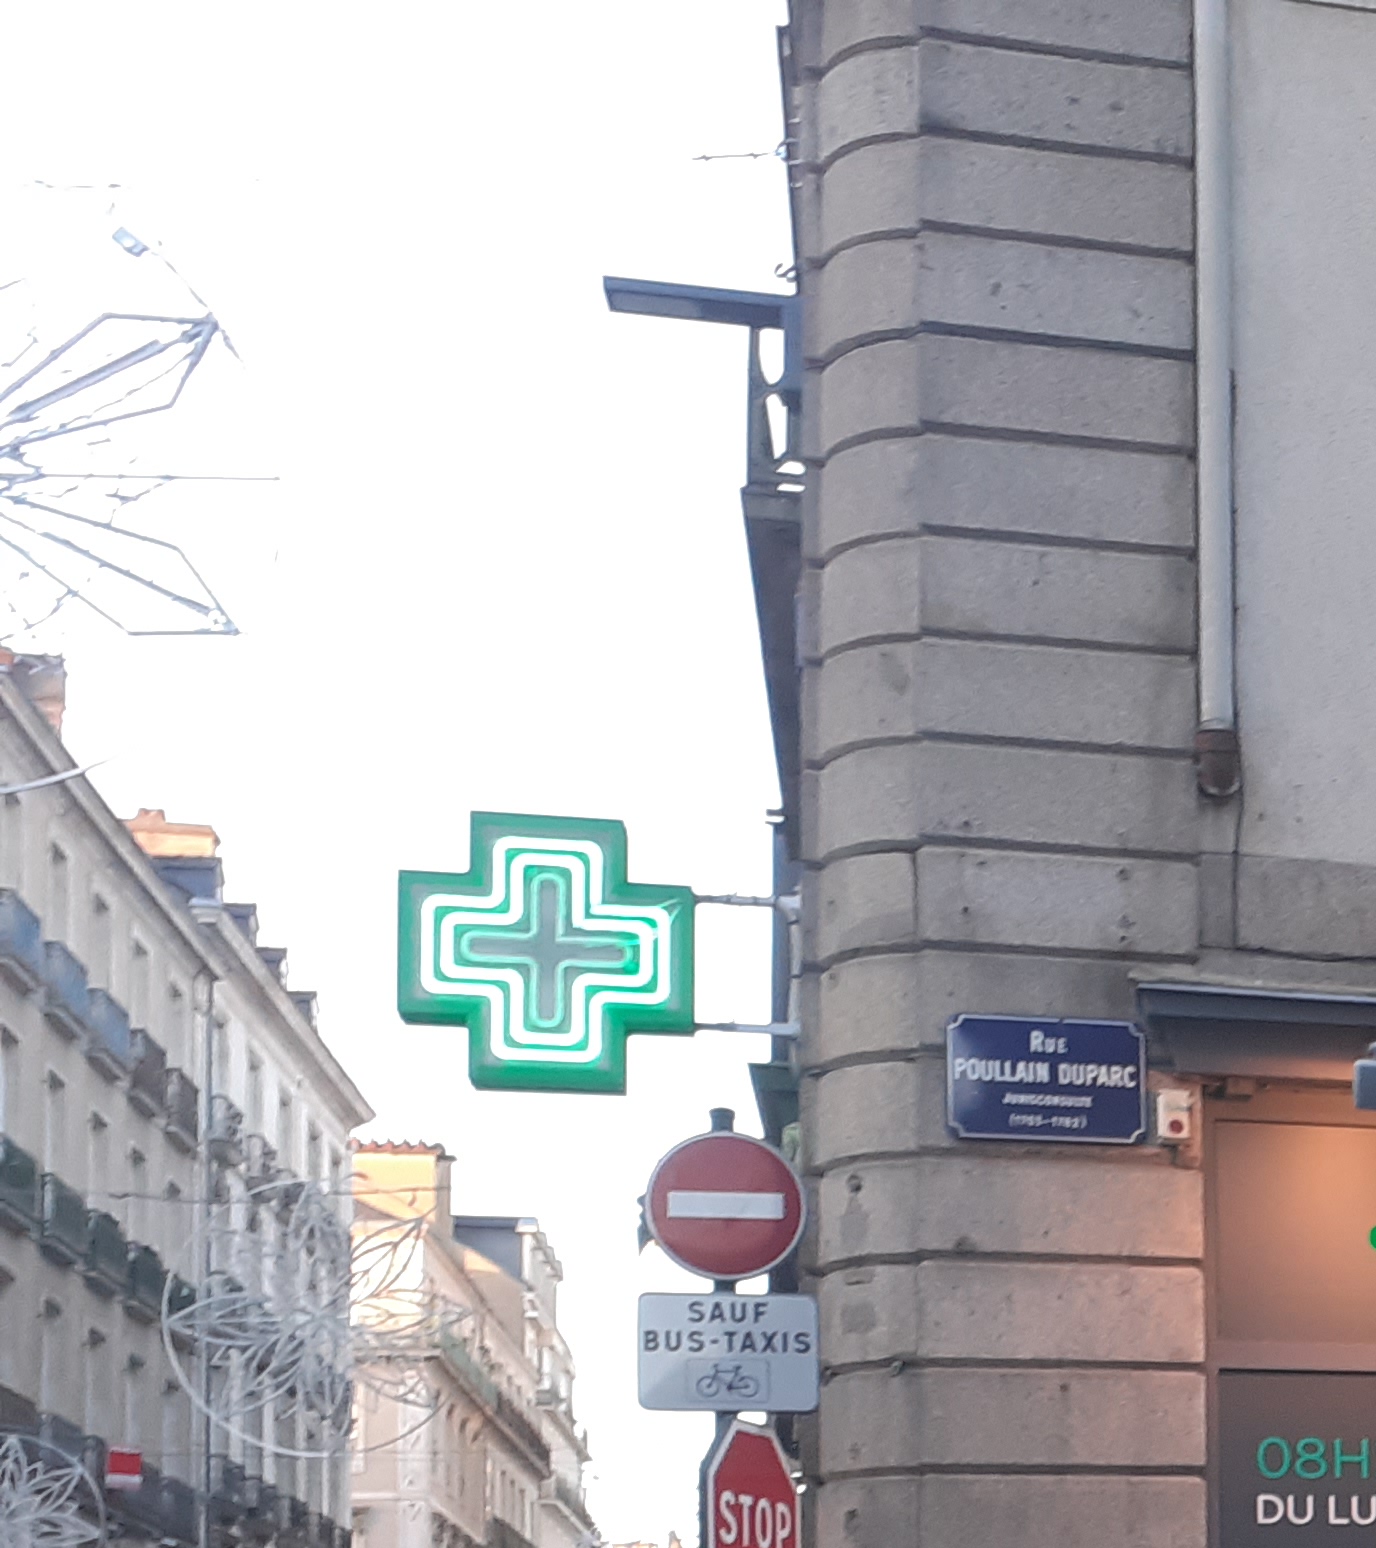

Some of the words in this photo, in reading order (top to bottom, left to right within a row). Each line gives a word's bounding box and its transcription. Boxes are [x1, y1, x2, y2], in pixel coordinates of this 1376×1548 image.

[953, 1057, 1050, 1084] POULLAIN
[1057, 1062, 1137, 1088] DUPARC
[687, 1300, 769, 1324] SAUF
[643, 1330, 811, 1354] BUS-TAXIS
[1256, 1493, 1315, 1526] DU
